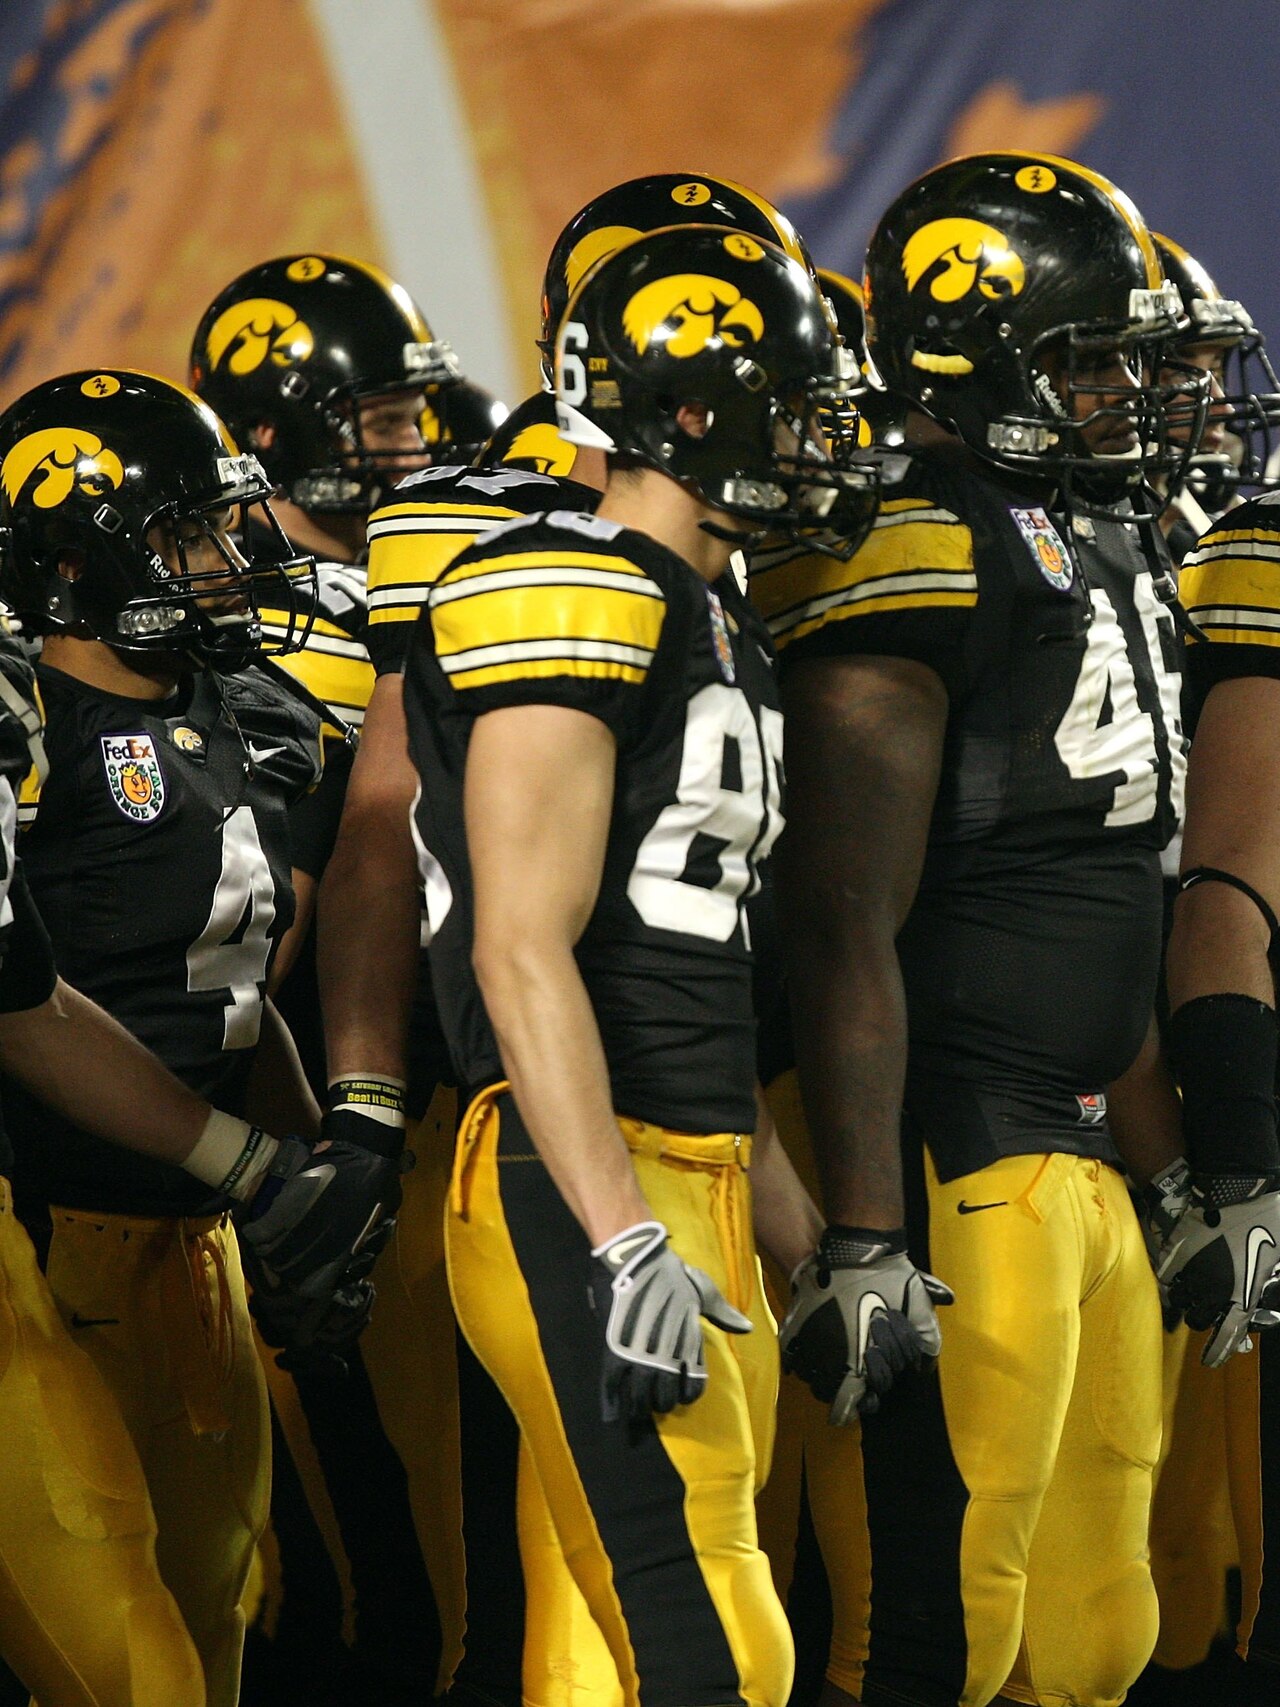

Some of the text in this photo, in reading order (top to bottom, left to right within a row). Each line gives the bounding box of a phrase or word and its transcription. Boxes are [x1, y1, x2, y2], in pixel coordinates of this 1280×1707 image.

[103, 739, 153, 760] FedEx
[186, 805, 274, 1050] 4
[347, 1092, 370, 1103] Beat
[379, 1095, 399, 1108] Buzz
